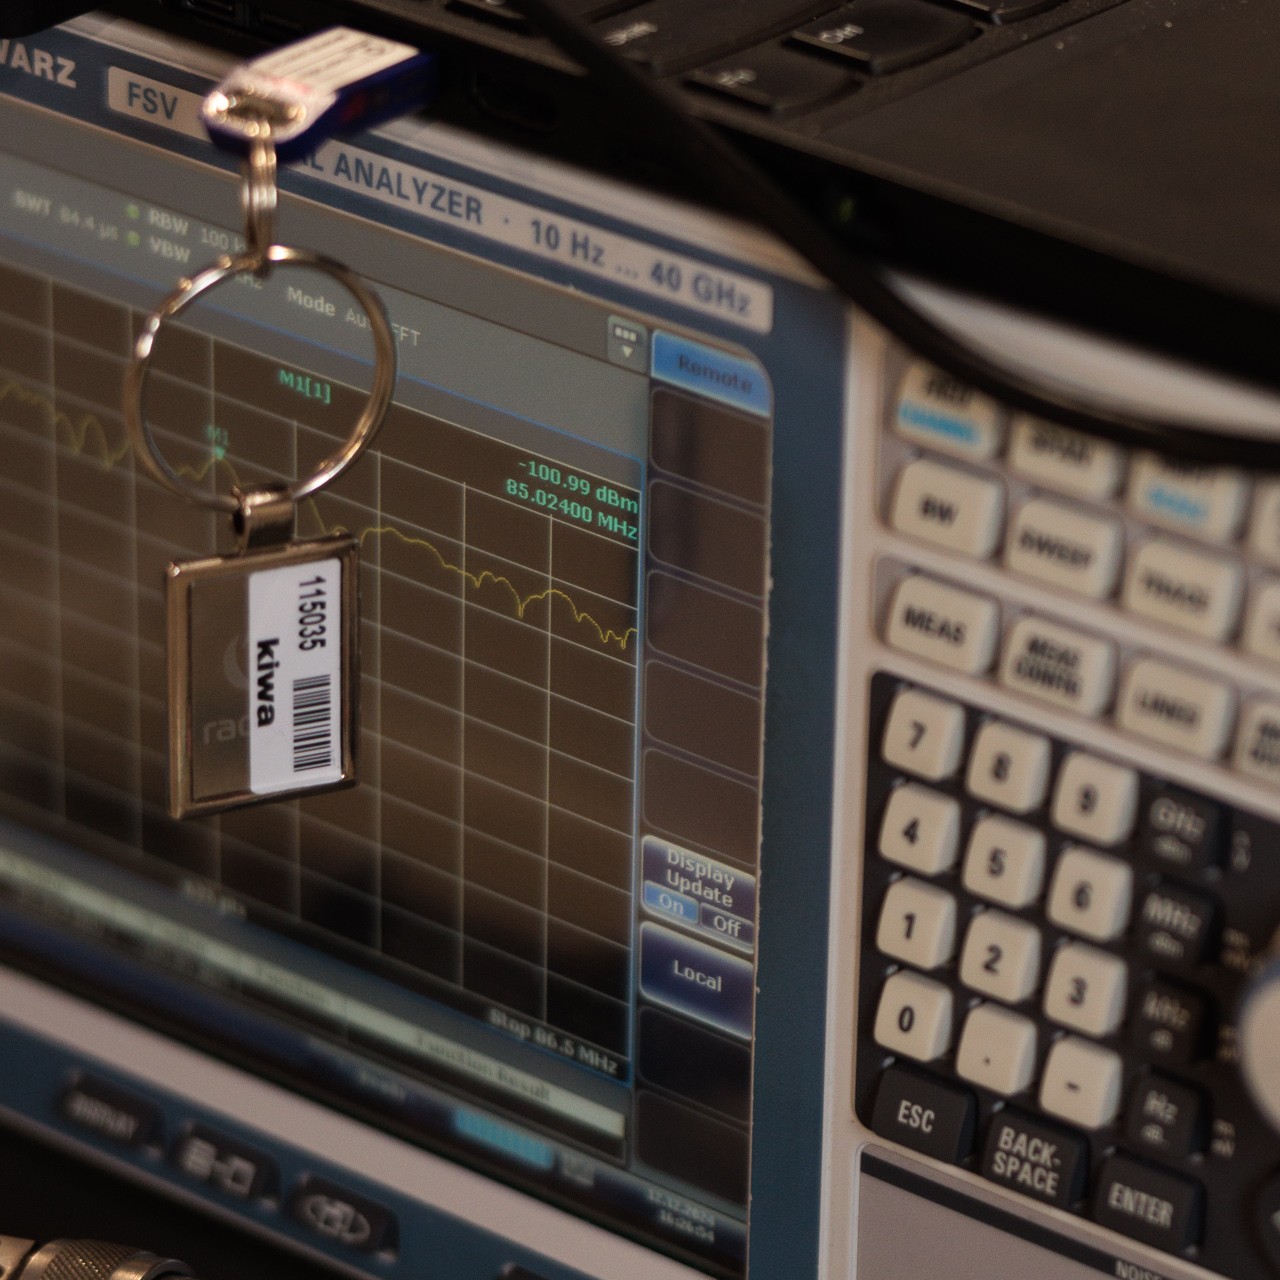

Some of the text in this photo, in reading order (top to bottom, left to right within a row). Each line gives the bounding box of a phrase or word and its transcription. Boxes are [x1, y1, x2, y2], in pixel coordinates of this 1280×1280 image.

[127, 81, 180, 120] FSV
[149, 208, 190, 237] RBW
[333, 151, 483, 224] ANALYZER
[529, 219, 562, 251] 10
[571, 230, 606, 268] Hz
[649, 258, 682, 292] 40
[692, 266, 754, 317] GHz
[150, 235, 191, 263] VBW
[287, 286, 337, 317] Mode
[278, 369, 331, 405] M1[1]
[678, 353, 753, 395] Remote
[518, 460, 639, 515] -100.99 dBm
[506, 478, 638, 541] 85.02400 MHz
[298, 575, 327, 652] 115035
[903, 605, 967, 647] MEAS
[256, 637, 280, 728] kiwa
[908, 719, 927, 750] 7
[993, 752, 1013, 783] 8
[903, 817, 920, 846] 4
[667, 848, 736, 891] Display
[987, 846, 1008, 879] 5
[666, 869, 734, 908] Update
[1072, 880, 1094, 911] 6
[659, 893, 742, 938] On Off
[903, 911, 917, 940] 1
[673, 960, 723, 993] Local
[982, 943, 1004, 974] 2
[1067, 975, 1088, 1008] 3
[897, 1005, 916, 1034] 0
[489, 1008, 531, 1041] Stop
[579, 1044, 619, 1076] MHz
[897, 1099, 936, 1134] ESC
[998, 1125, 1062, 1168] BACK-
[991, 1150, 1060, 1197] SPACE
[1107, 1181, 1175, 1231] ENTER
